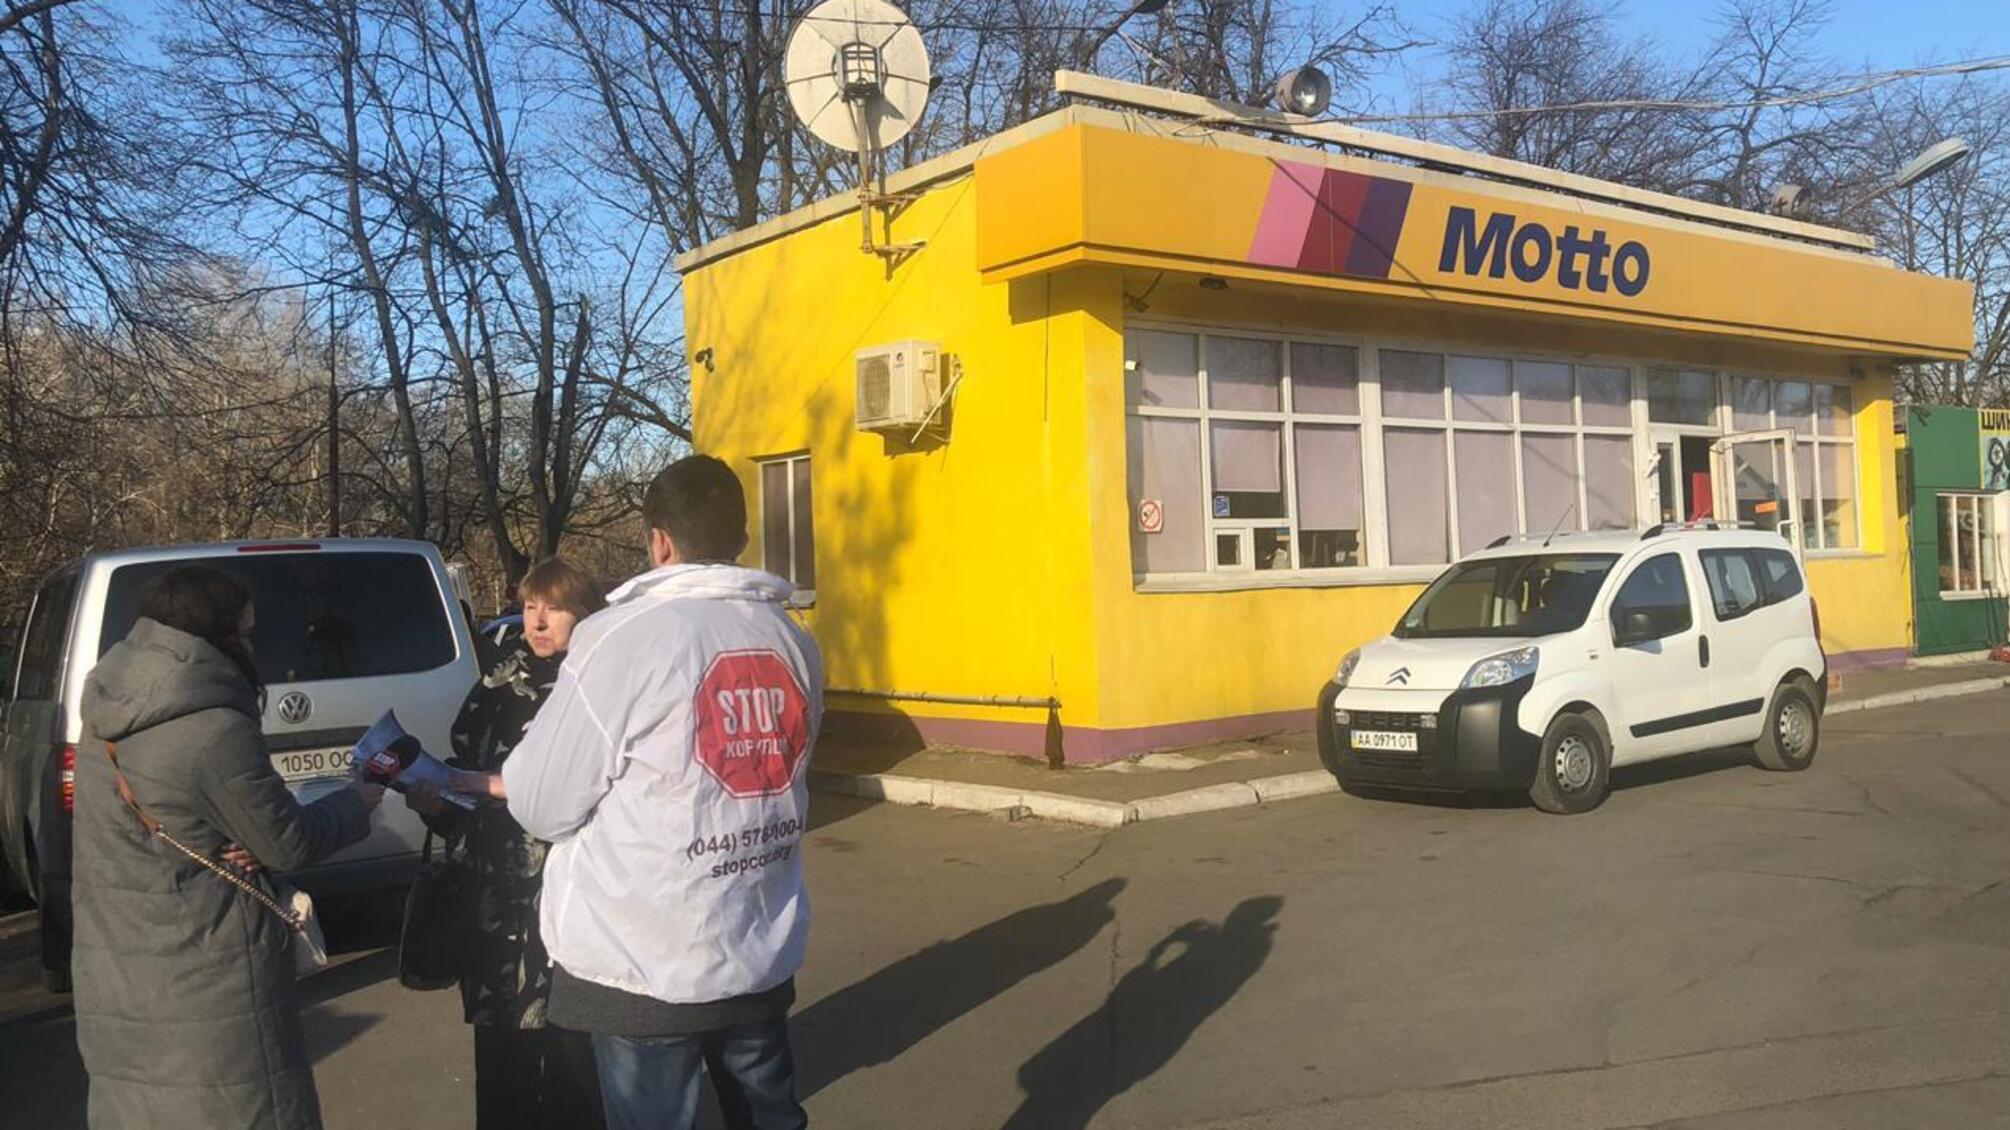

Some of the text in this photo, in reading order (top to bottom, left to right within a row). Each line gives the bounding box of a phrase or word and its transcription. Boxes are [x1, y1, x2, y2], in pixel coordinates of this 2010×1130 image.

[1438, 205, 1650, 298] Motto
[717, 687, 785, 735] STOP
[281, 753, 324, 773] 1050
[687, 832, 737, 861] (044)
